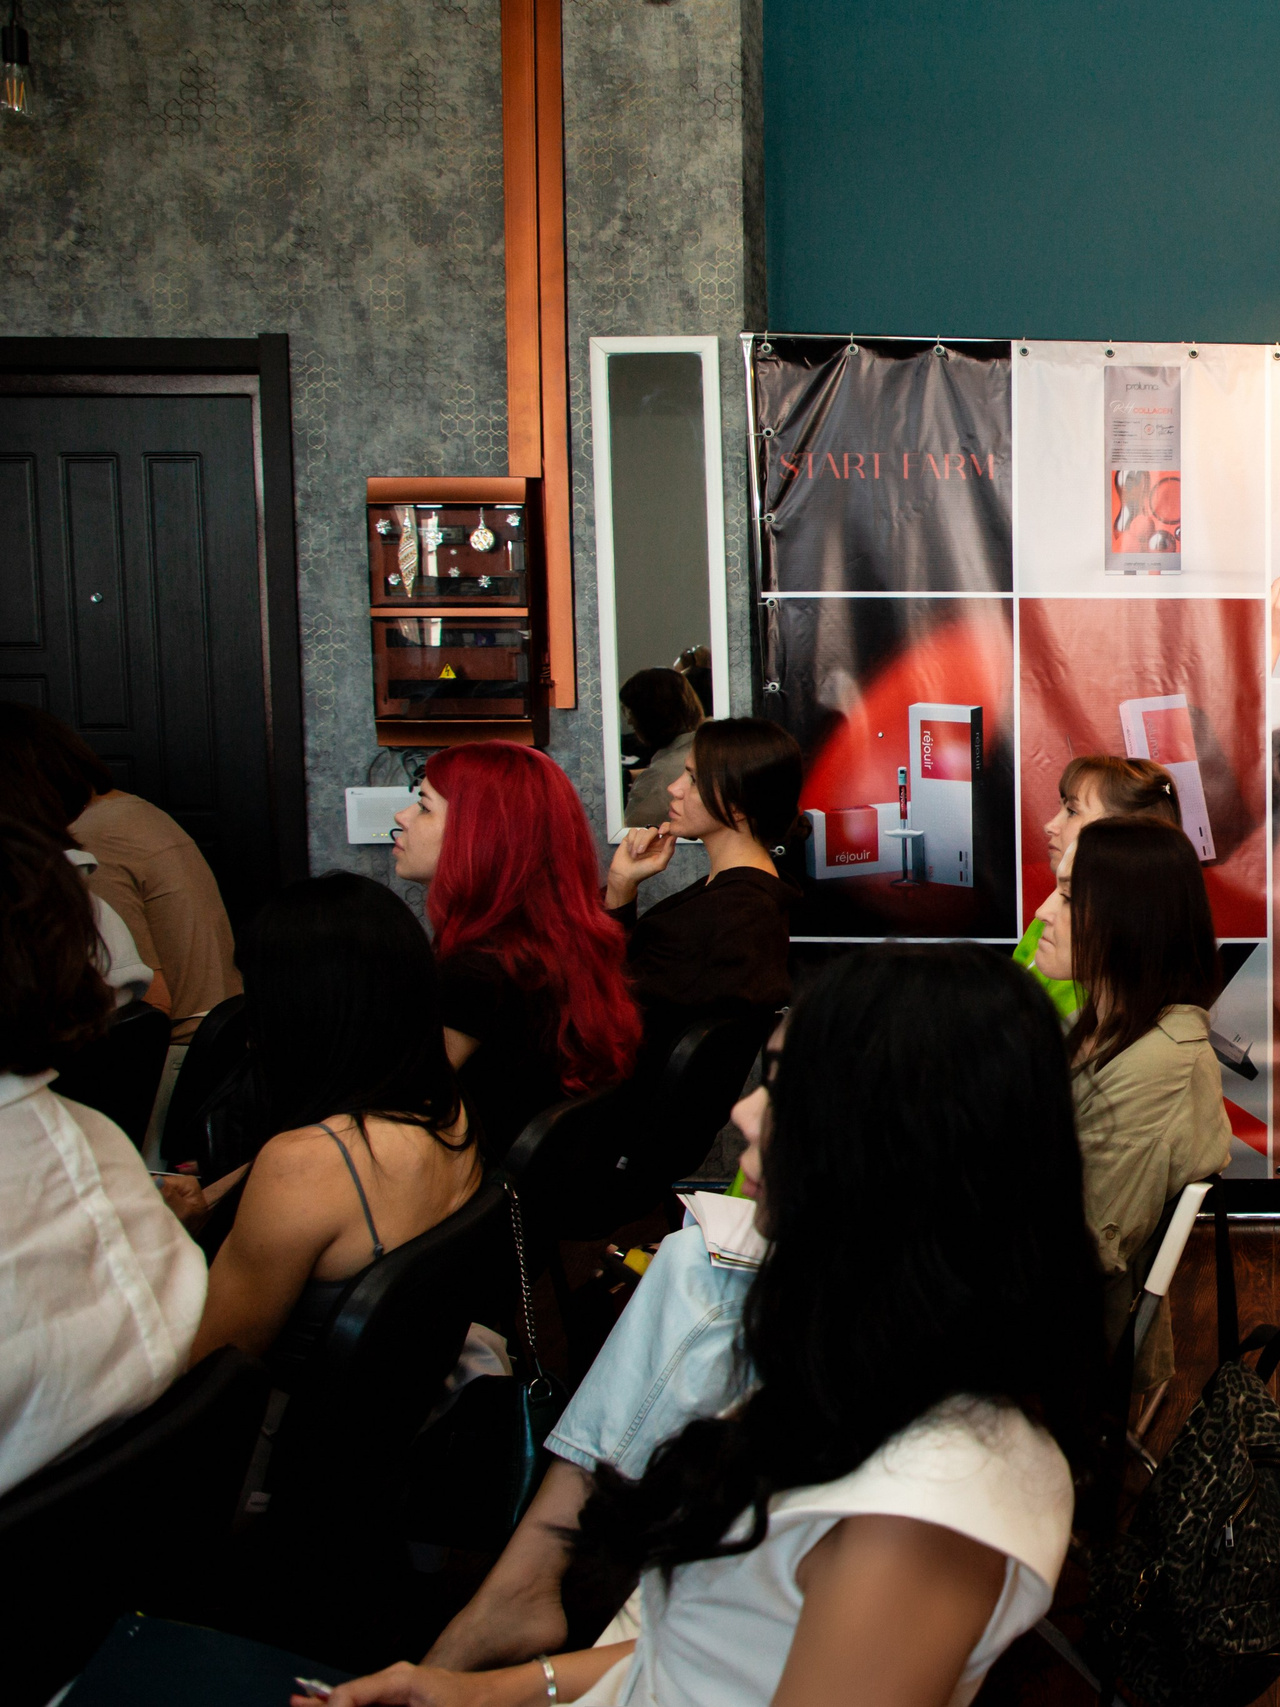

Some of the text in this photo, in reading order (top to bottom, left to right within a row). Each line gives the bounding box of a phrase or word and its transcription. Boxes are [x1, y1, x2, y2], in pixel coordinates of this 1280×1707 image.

[779, 452, 995, 480] START FARM
[923, 730, 934, 770] réjouir
[835, 850, 871, 864] réjouir
